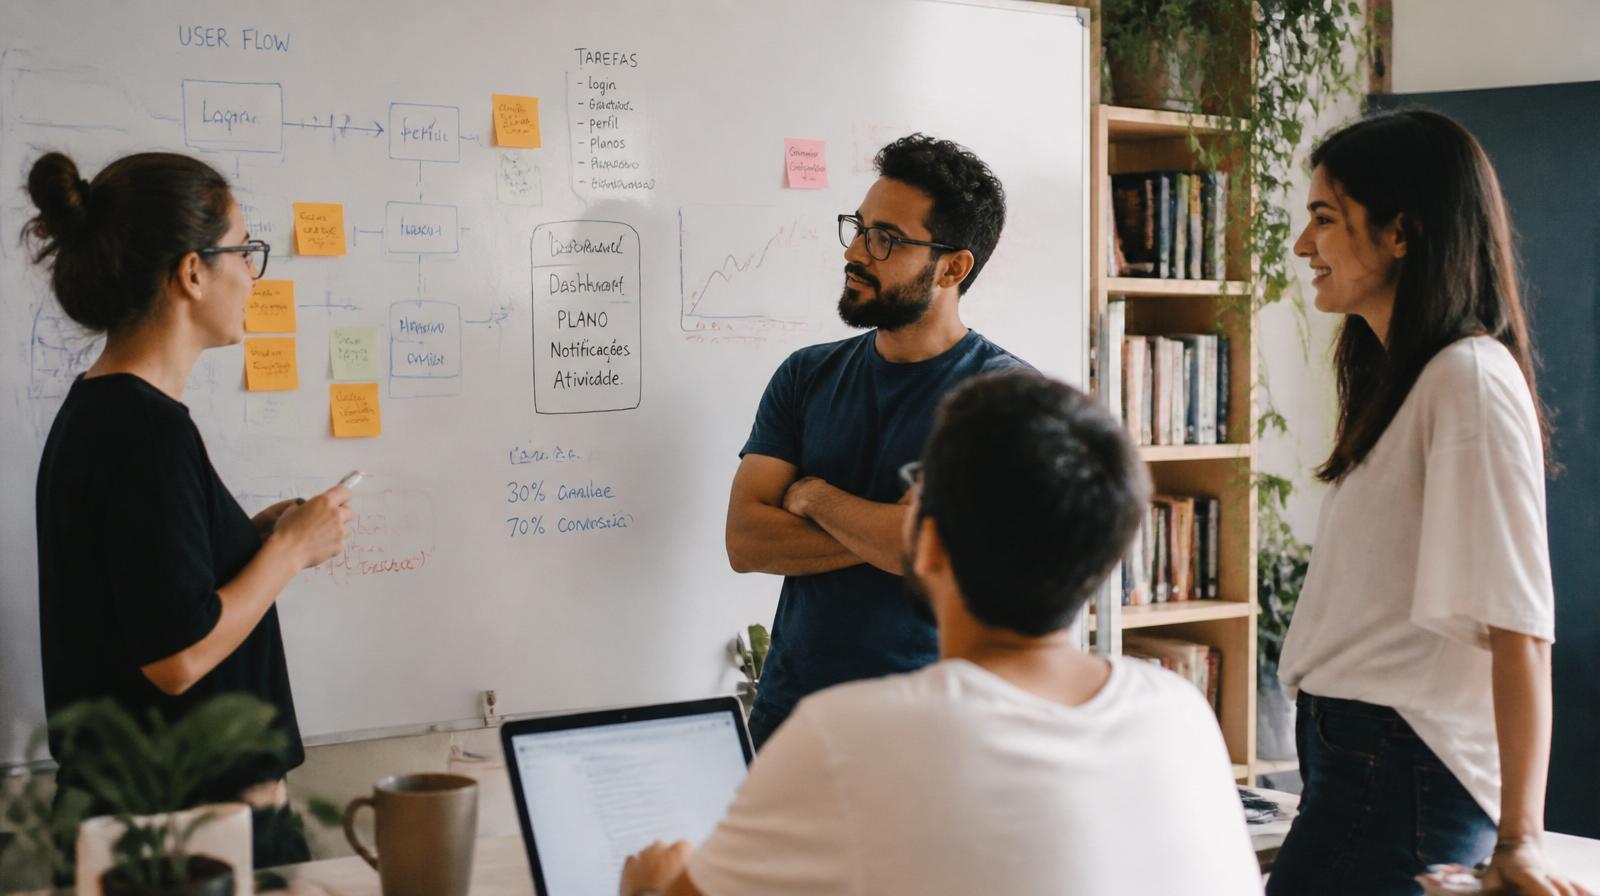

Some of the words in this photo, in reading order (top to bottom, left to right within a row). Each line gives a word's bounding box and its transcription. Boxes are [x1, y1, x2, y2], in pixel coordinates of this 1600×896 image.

[179, 24, 230, 47] USER
[242, 28, 290, 52] FLOW
[574, 47, 638, 68] TAREFAS
[588, 75, 616, 96] login
[589, 114, 618, 134] perfil
[557, 309, 608, 329] PLANO
[507, 480, 546, 504] 30%
[506, 515, 546, 537] 70%
